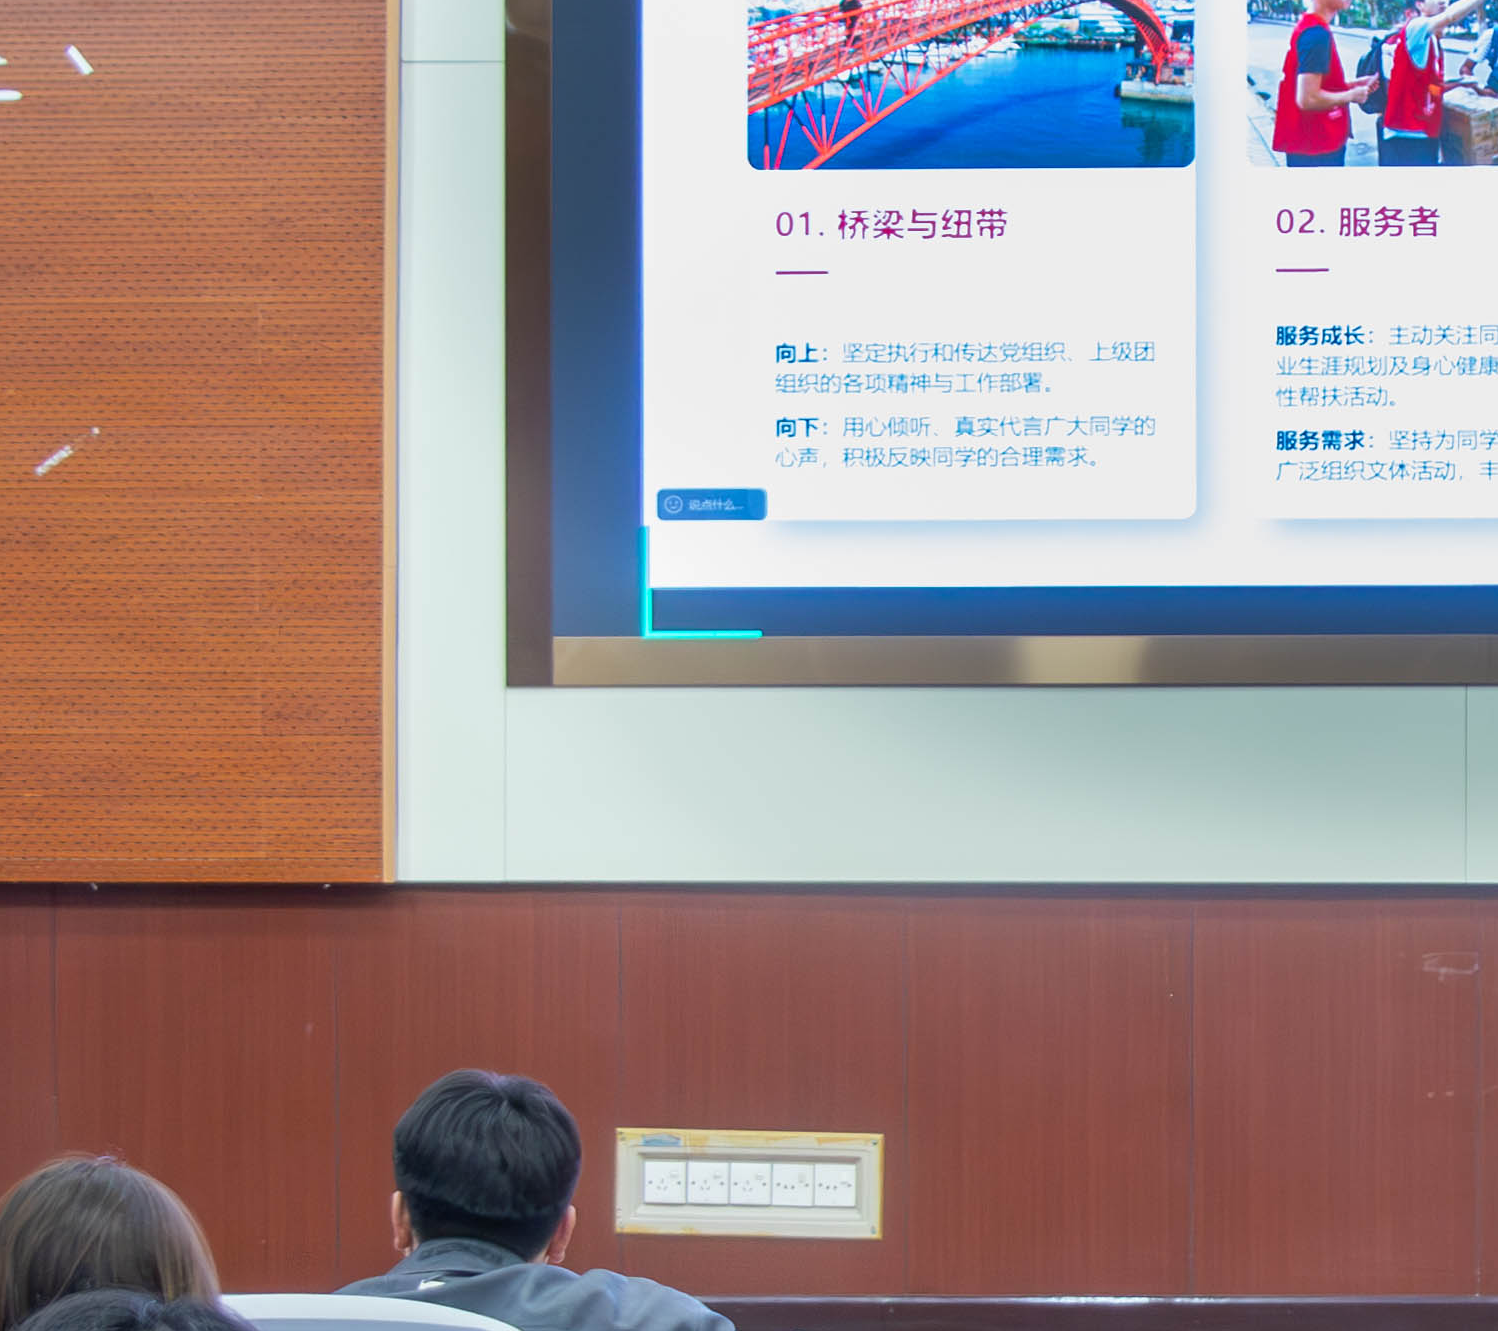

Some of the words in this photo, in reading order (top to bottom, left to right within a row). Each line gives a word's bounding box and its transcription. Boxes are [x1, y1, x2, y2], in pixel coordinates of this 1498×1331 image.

[776, 212, 824, 236] 01.
[838, 209, 1008, 240] 桥梁与纽带
[1276, 209, 1325, 234] 02.
[1339, 206, 1440, 237] 服务者
